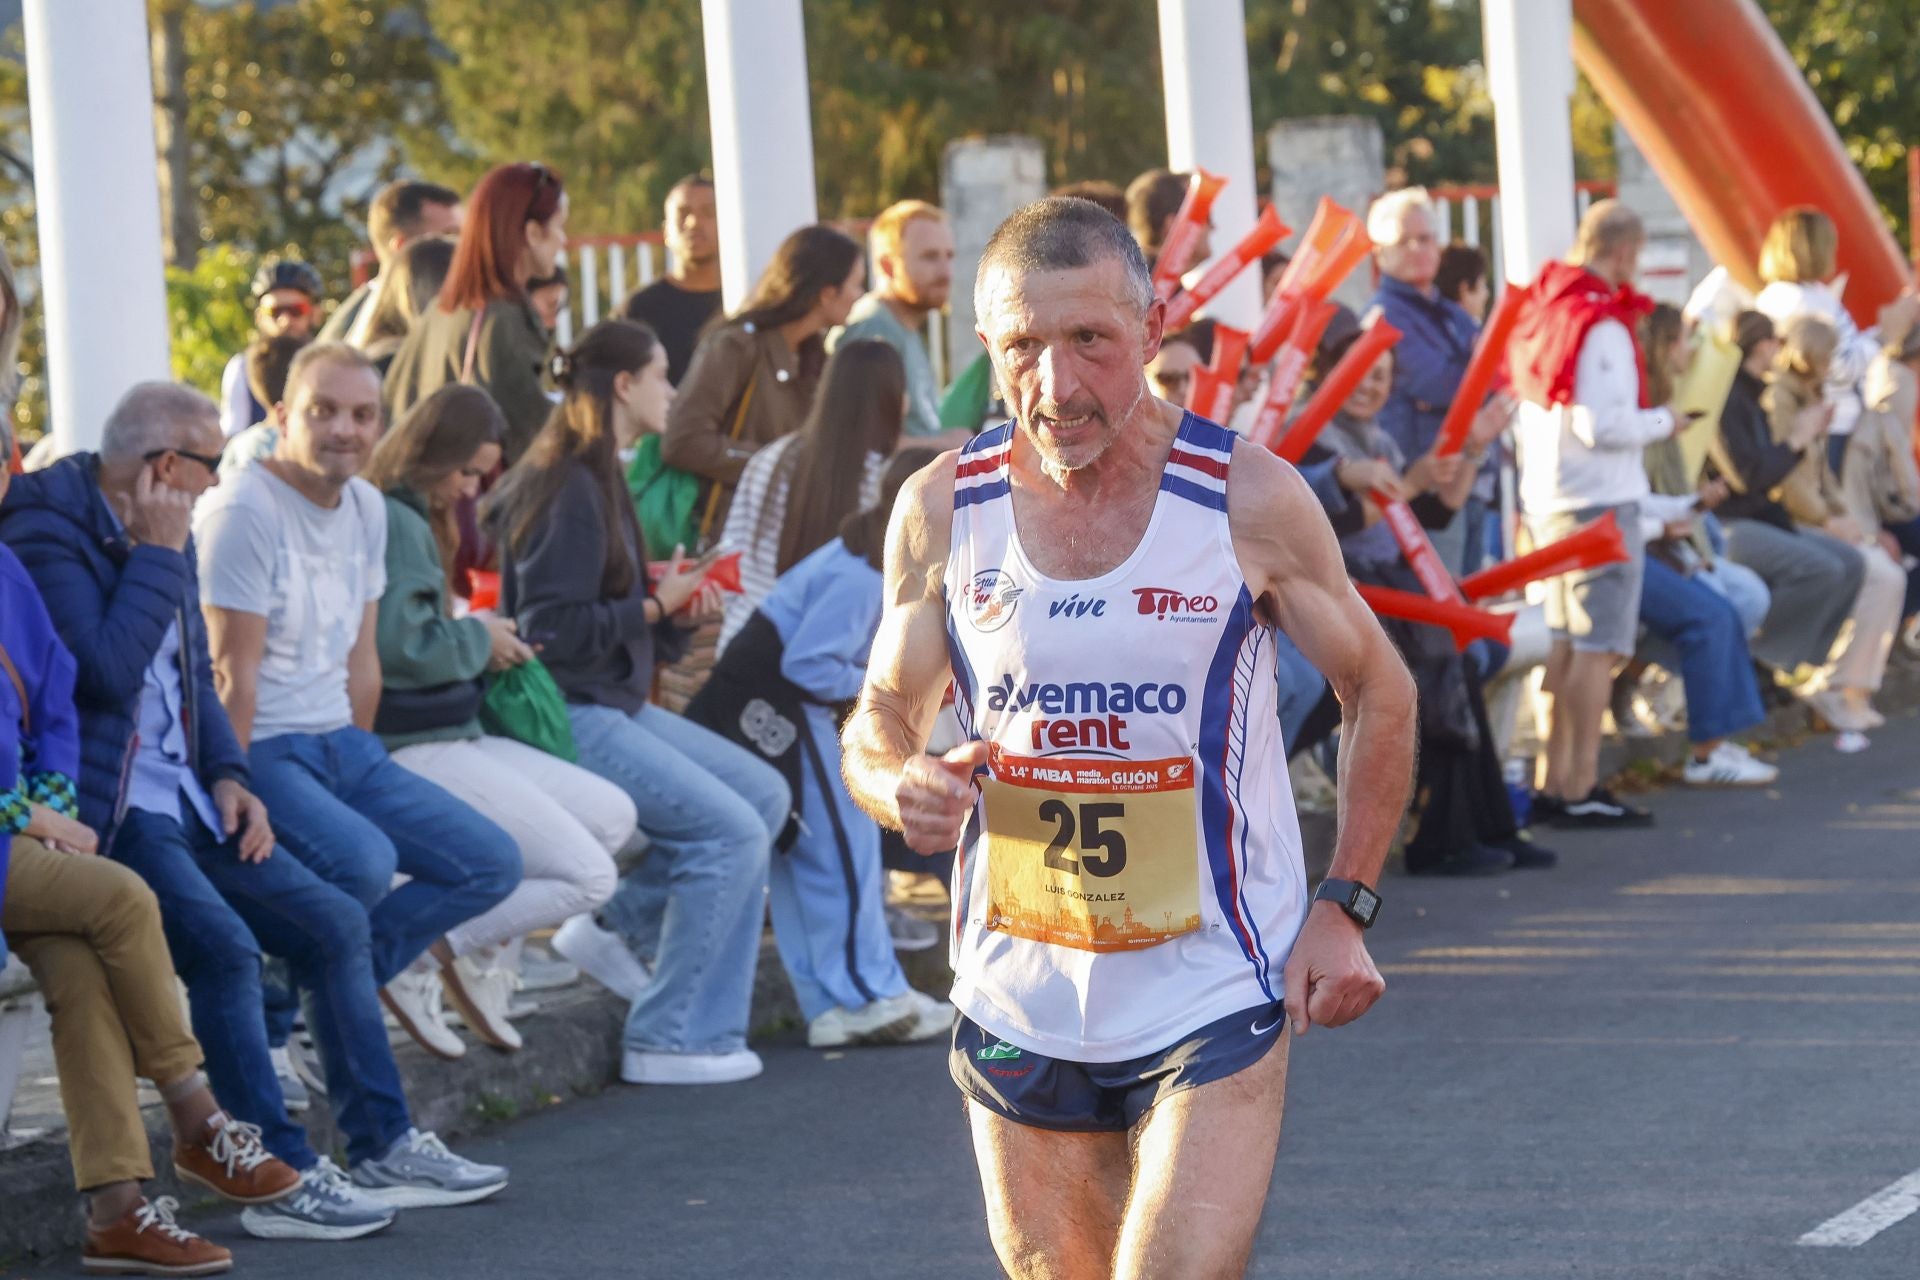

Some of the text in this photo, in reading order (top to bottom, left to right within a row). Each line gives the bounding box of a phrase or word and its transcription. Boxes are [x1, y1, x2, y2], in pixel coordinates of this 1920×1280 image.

[1131, 587, 1218, 621] Tineo
[1169, 614, 1218, 623] Ayuntamiento
[987, 673, 1187, 715] alvemaco
[1031, 713, 1131, 750] rent
[1032, 768, 1074, 784] MBA
[1076, 769, 1101, 778] media
[1076, 776, 1110, 785] maratón
[1111, 769, 1159, 785] GIJÓN
[1039, 799, 1127, 878] 25
[1045, 884, 1126, 902] LUIS GONZALEZ
